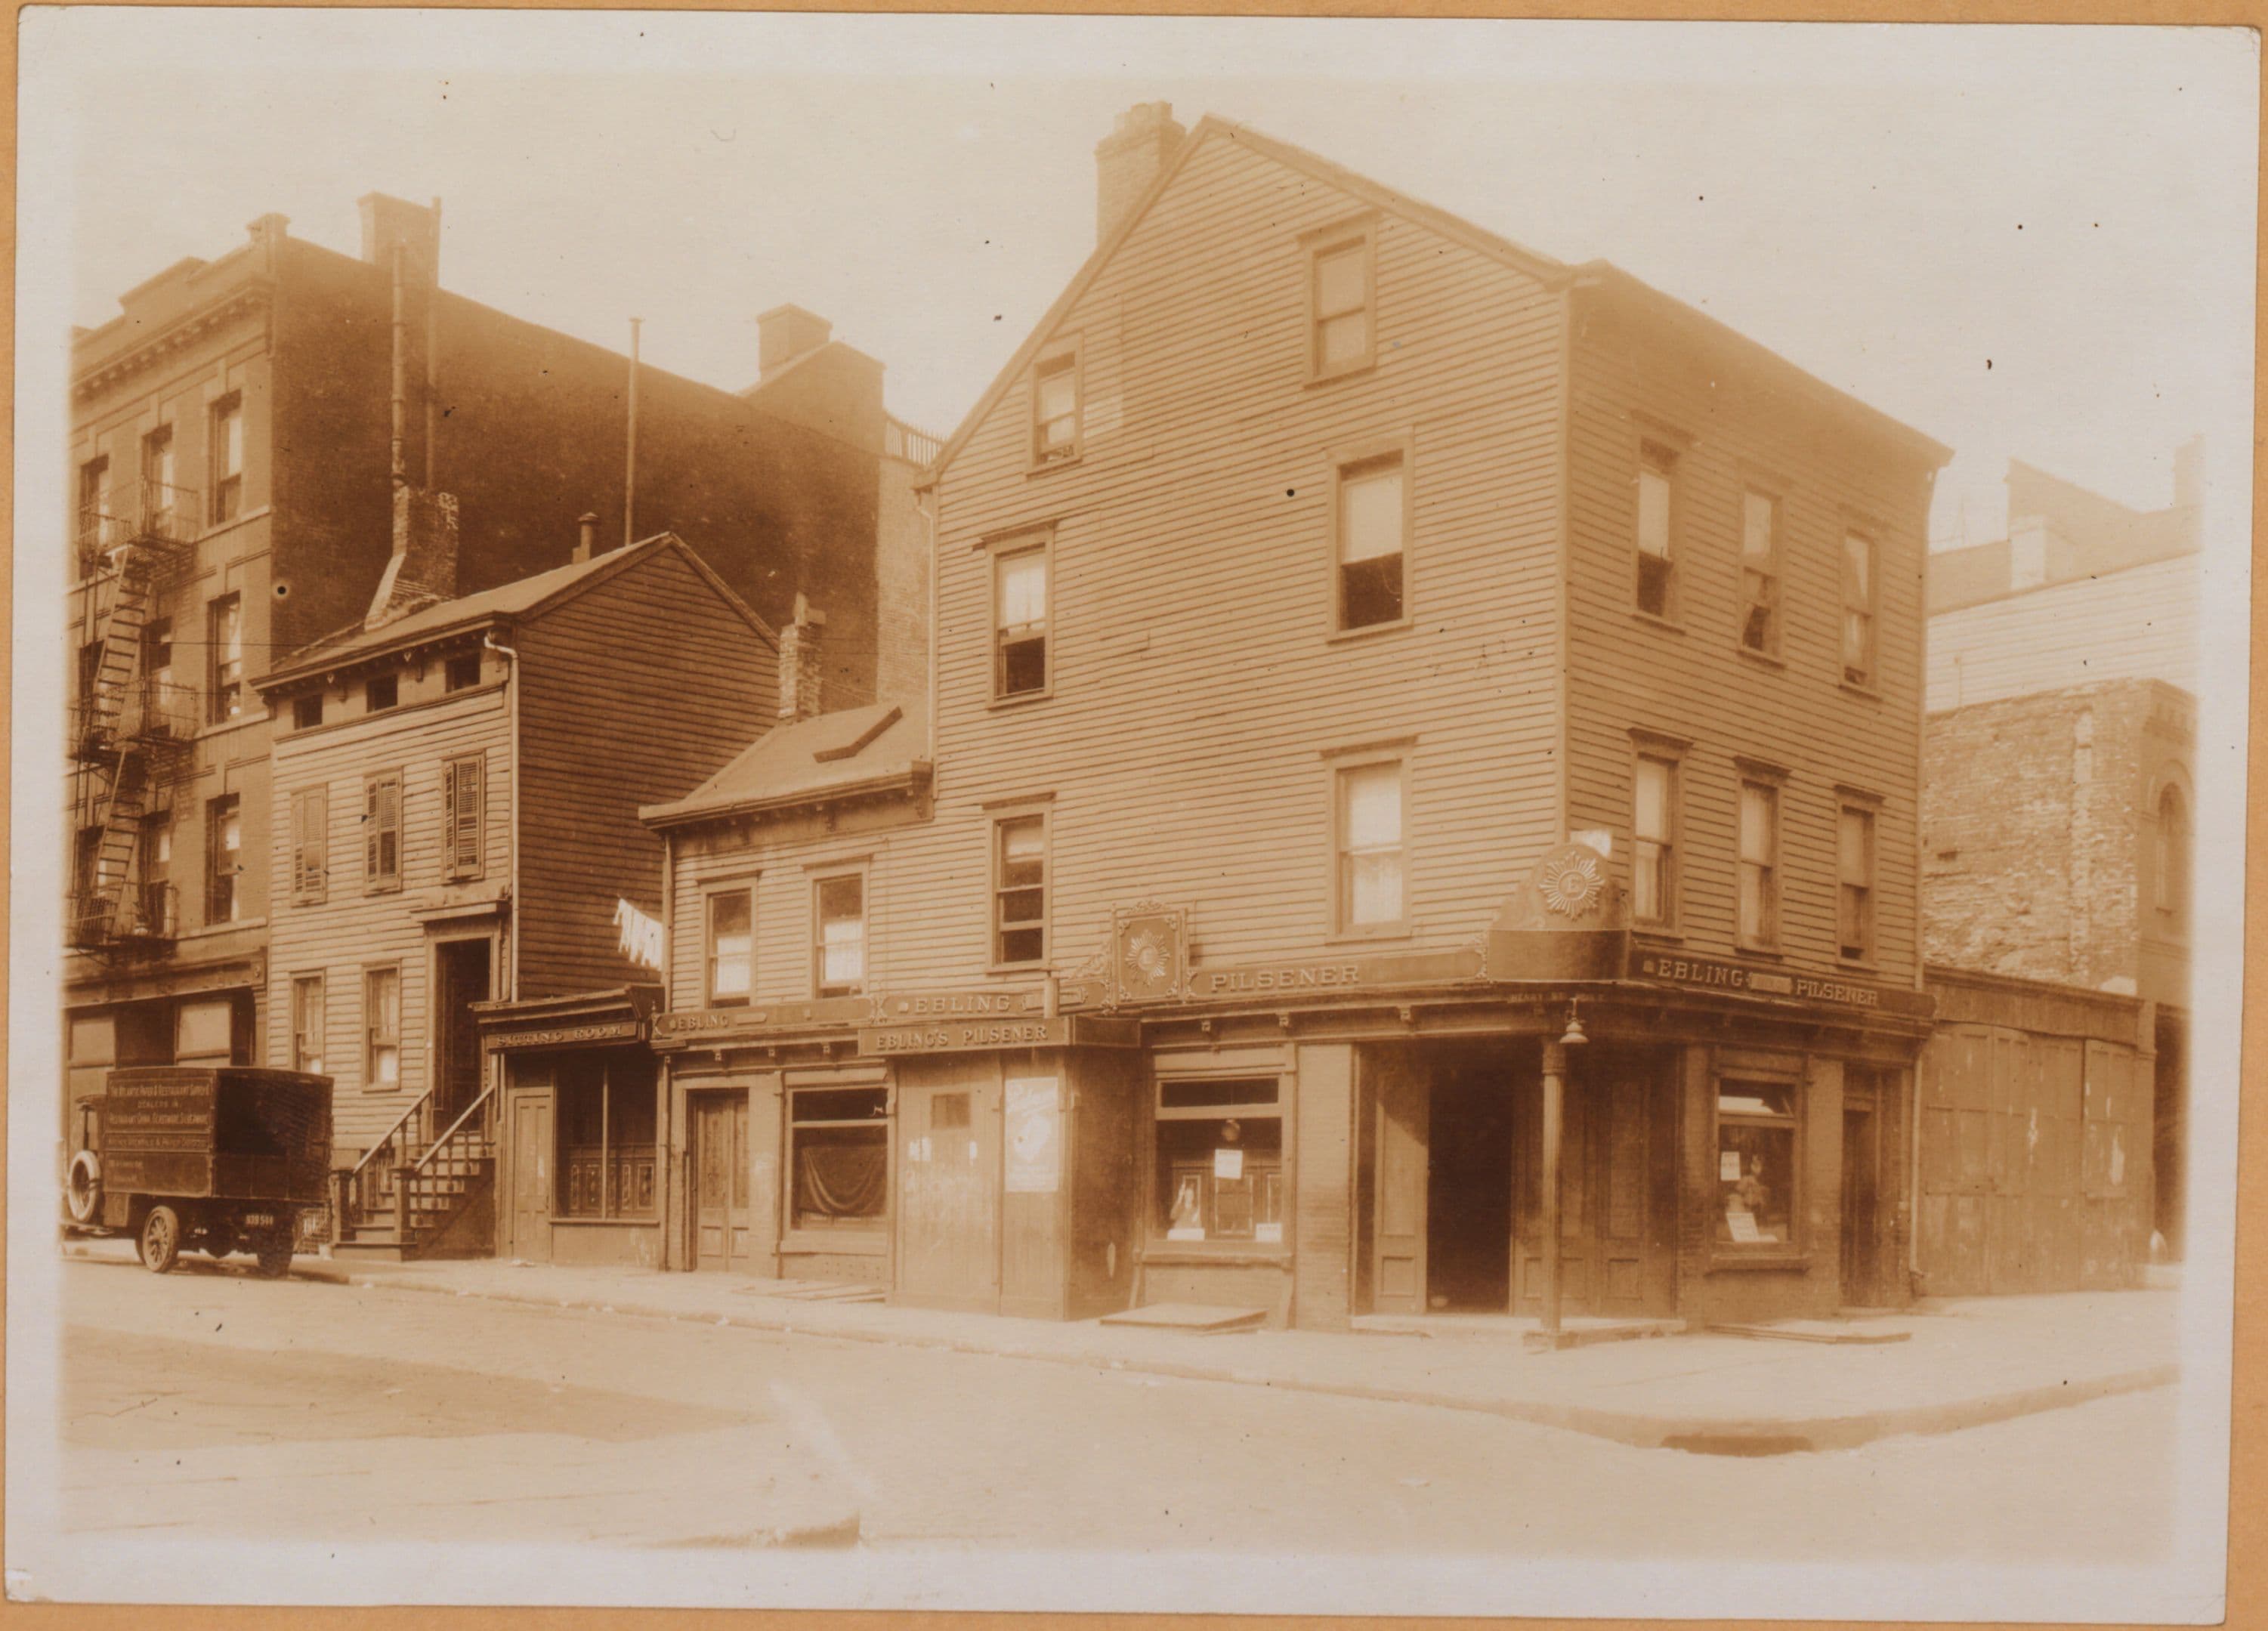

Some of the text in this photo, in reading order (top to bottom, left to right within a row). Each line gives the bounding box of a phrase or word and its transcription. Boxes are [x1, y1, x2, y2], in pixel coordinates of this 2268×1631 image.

[1210, 965, 1359, 993] PILSENER
[1658, 959, 1878, 1006] EBLING PILSENER
[914, 995, 1012, 1015] EBLING
[573, 1024, 623, 1040] ROOM
[678, 1015, 729, 1031] EBLING
[876, 1025, 1049, 1052] EBLING'S PILSENER
